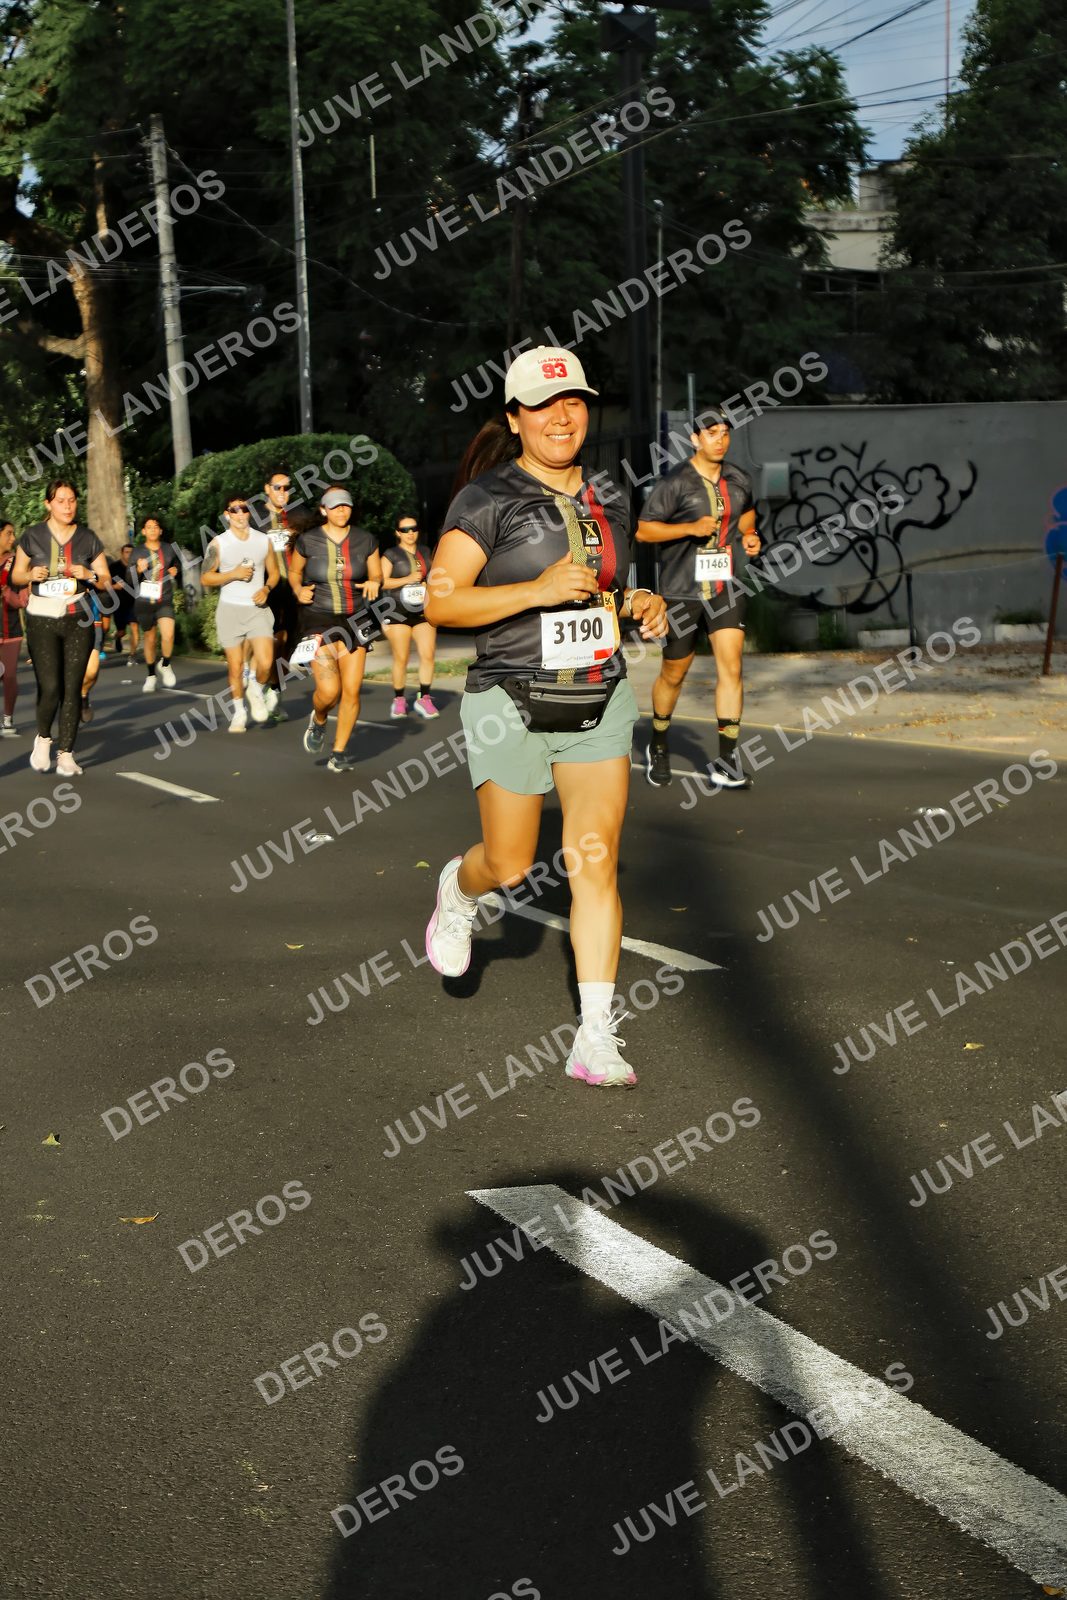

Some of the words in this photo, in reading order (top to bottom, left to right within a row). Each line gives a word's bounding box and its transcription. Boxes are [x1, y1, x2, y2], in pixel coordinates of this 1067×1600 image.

[542, 362, 567, 379] 93
[790, 440, 867, 471] TOY
[700, 557, 728, 569] 11465
[45, 582, 69, 592] 1676
[554, 616, 603, 644] 3190
